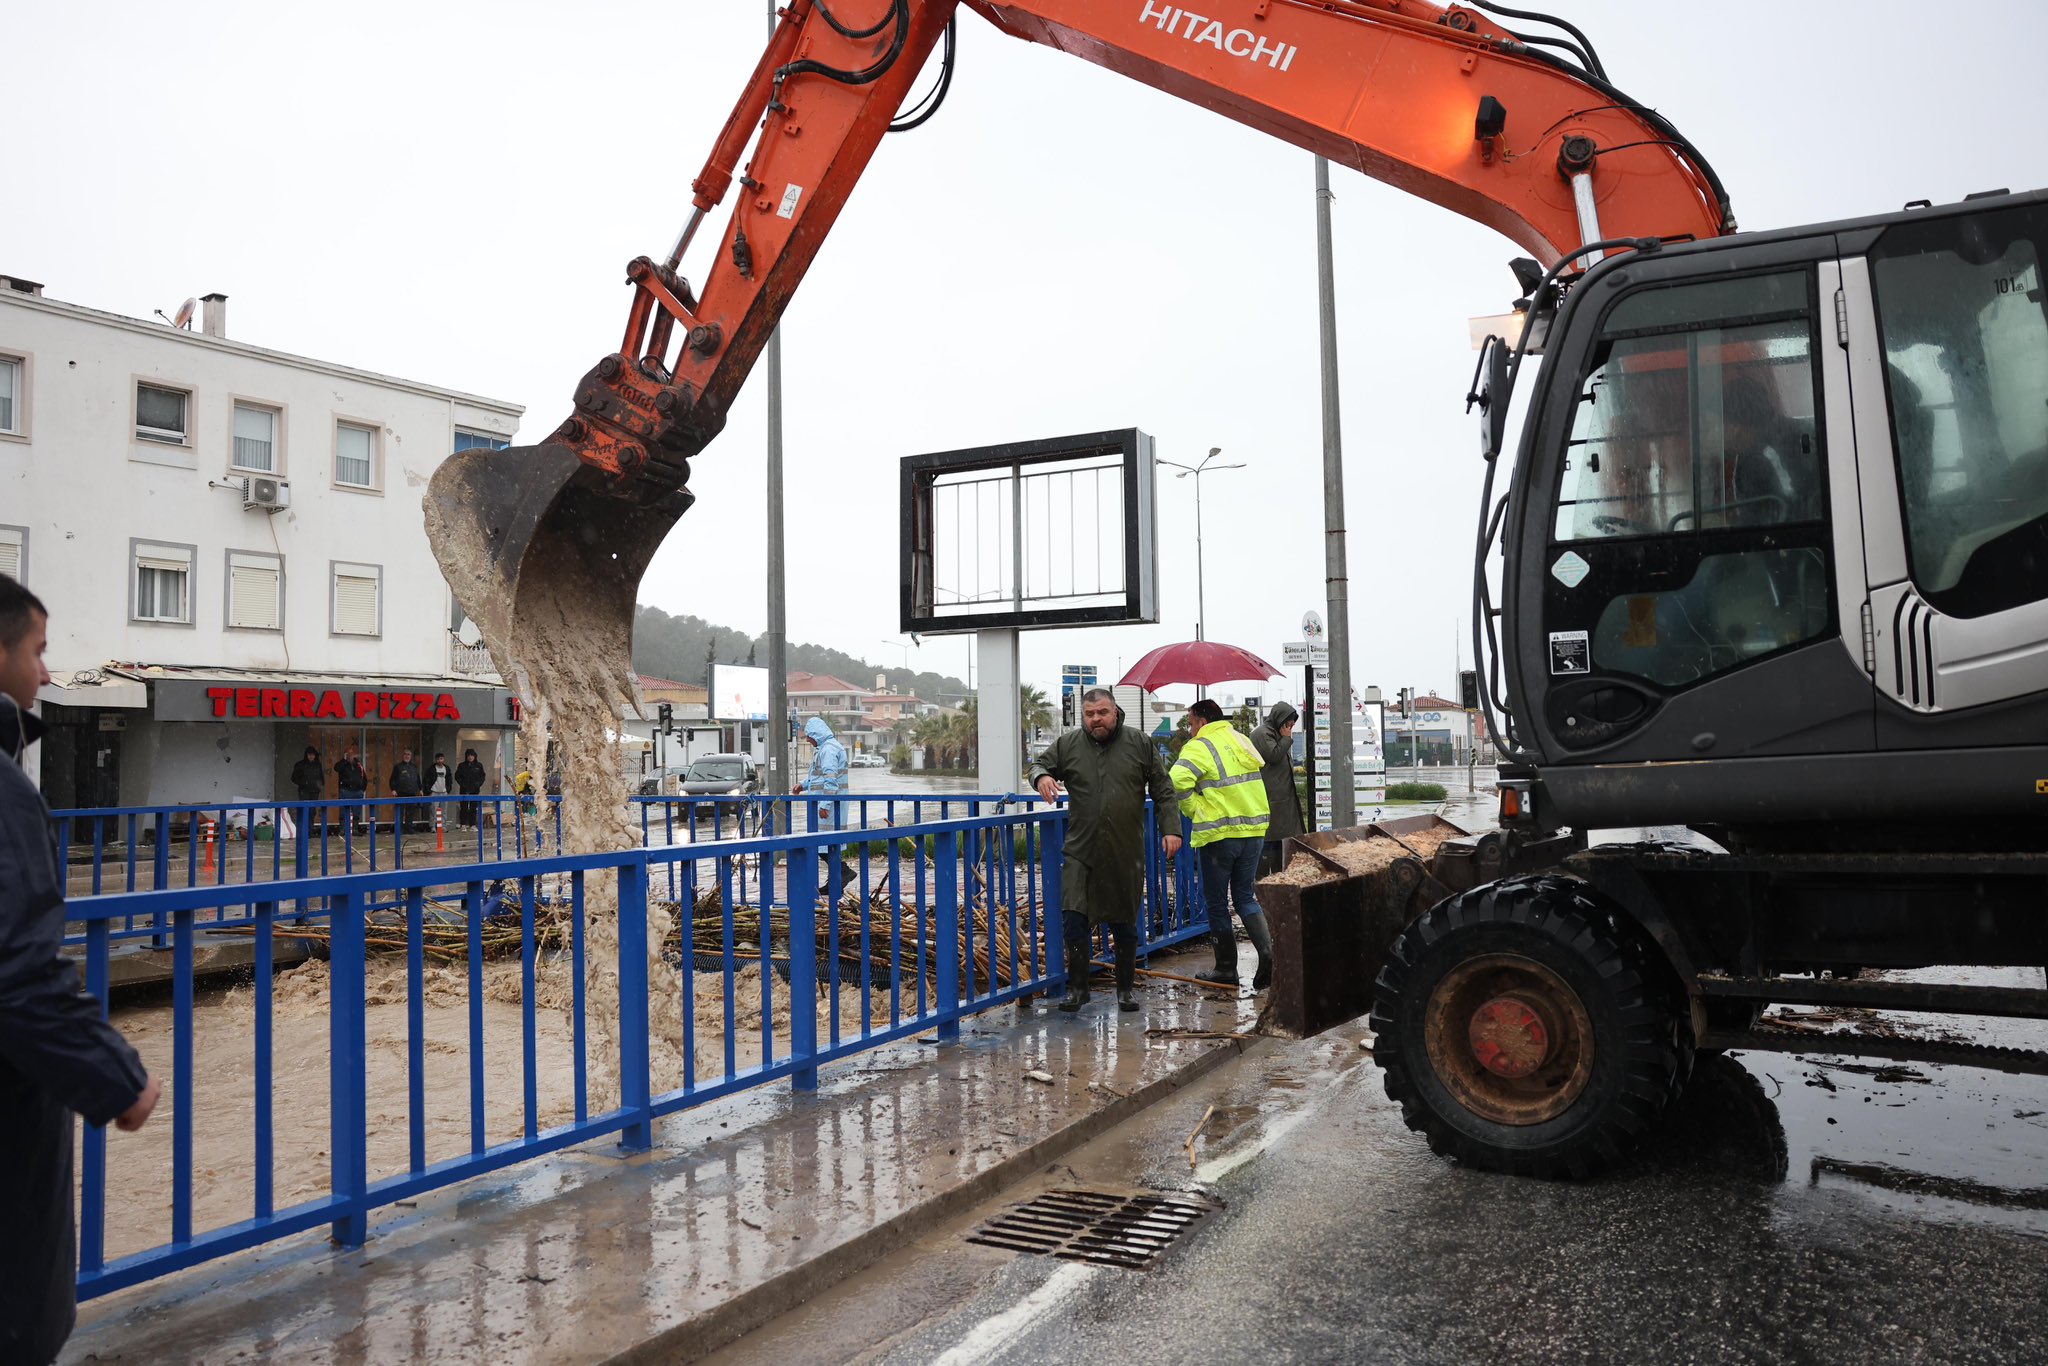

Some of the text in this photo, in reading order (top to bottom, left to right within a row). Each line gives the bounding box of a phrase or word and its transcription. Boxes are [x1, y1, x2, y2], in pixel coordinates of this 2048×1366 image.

[1139, 0, 1297, 72] HITACHI
[1994, 277, 2015, 295] 101
[1561, 632, 1586, 640] WARNING
[207, 687, 347, 718] TERRA
